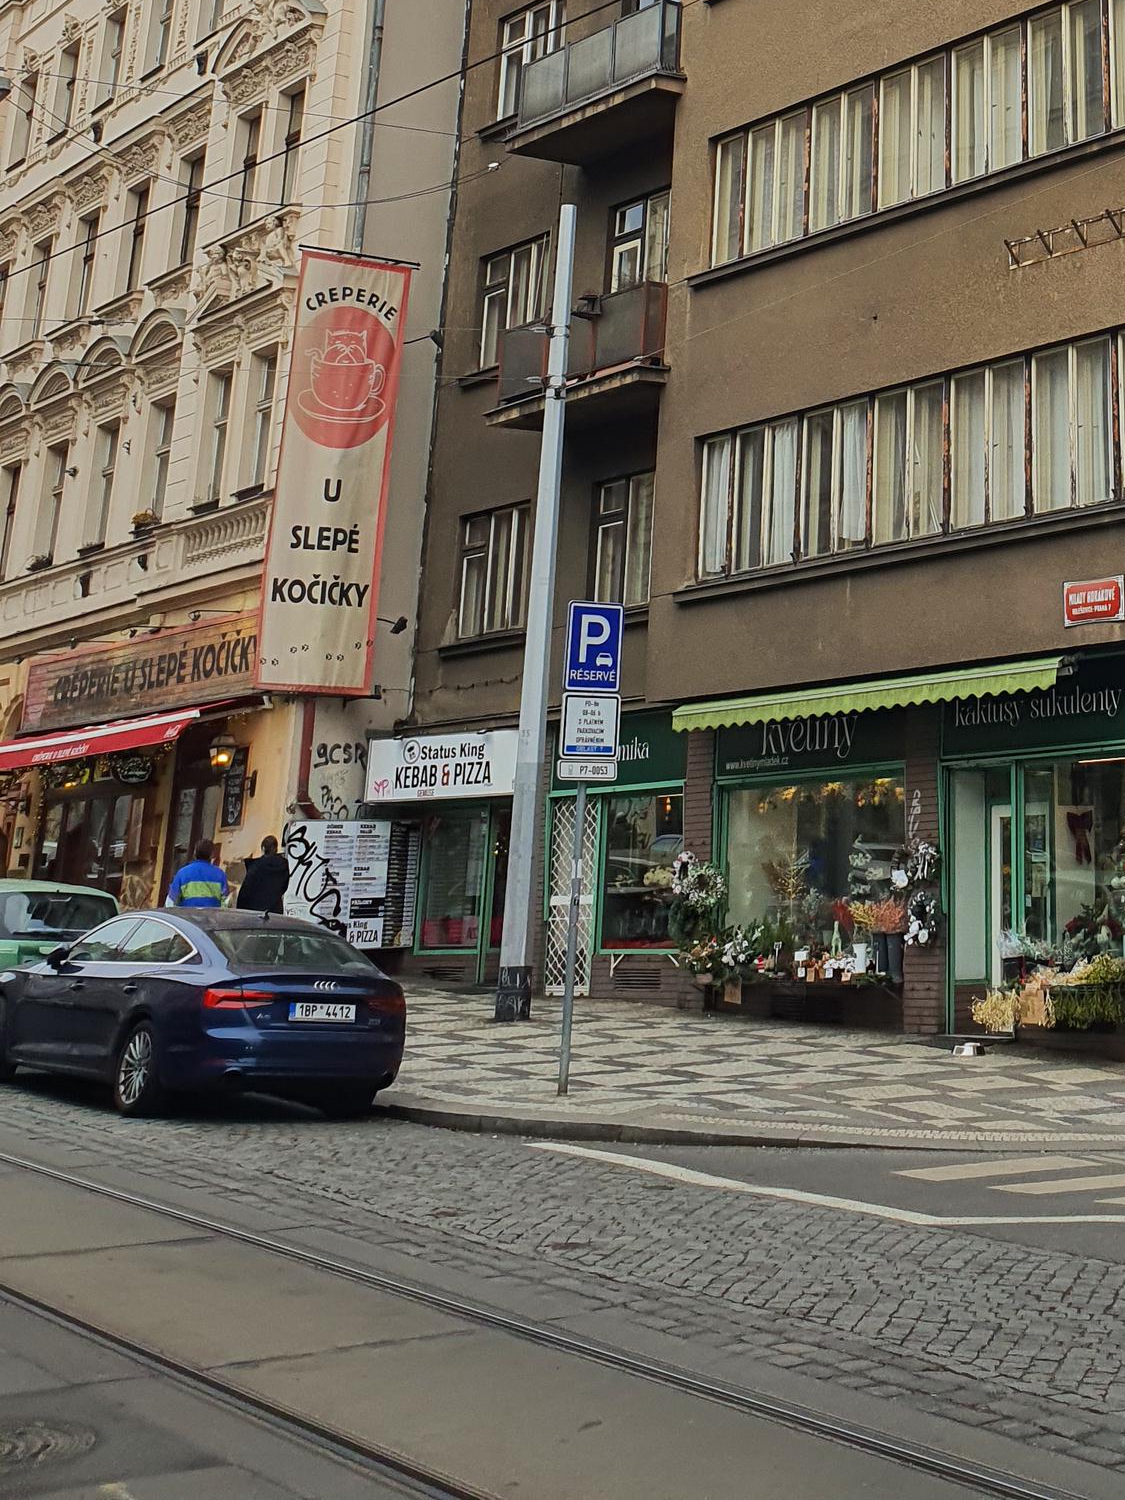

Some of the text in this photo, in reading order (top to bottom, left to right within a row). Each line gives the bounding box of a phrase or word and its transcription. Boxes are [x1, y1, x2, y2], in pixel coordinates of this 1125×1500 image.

[306, 286, 398, 321] CREPERIE
[324, 478, 342, 502] U
[290, 524, 360, 553] SLEPÉ
[271, 574, 369, 607] KOČIČKY
[579, 614, 611, 663] P
[140, 641, 187, 690] SLEPÉ
[191, 630, 257, 682] KOČIČK
[570, 668, 616, 681] RÉSERVÉ
[1030, 686, 1122, 716] sukulenty
[421, 743, 485, 760] Status King
[394, 765, 438, 789] KEBAB
[441, 763, 450, 786] &
[453, 761, 491, 785] PIZZA
[580, 765, 608, 775] P7-0053
[356, 930, 378, 943] PIZZA
[299, 1004, 351, 1018] 1BP 4412
